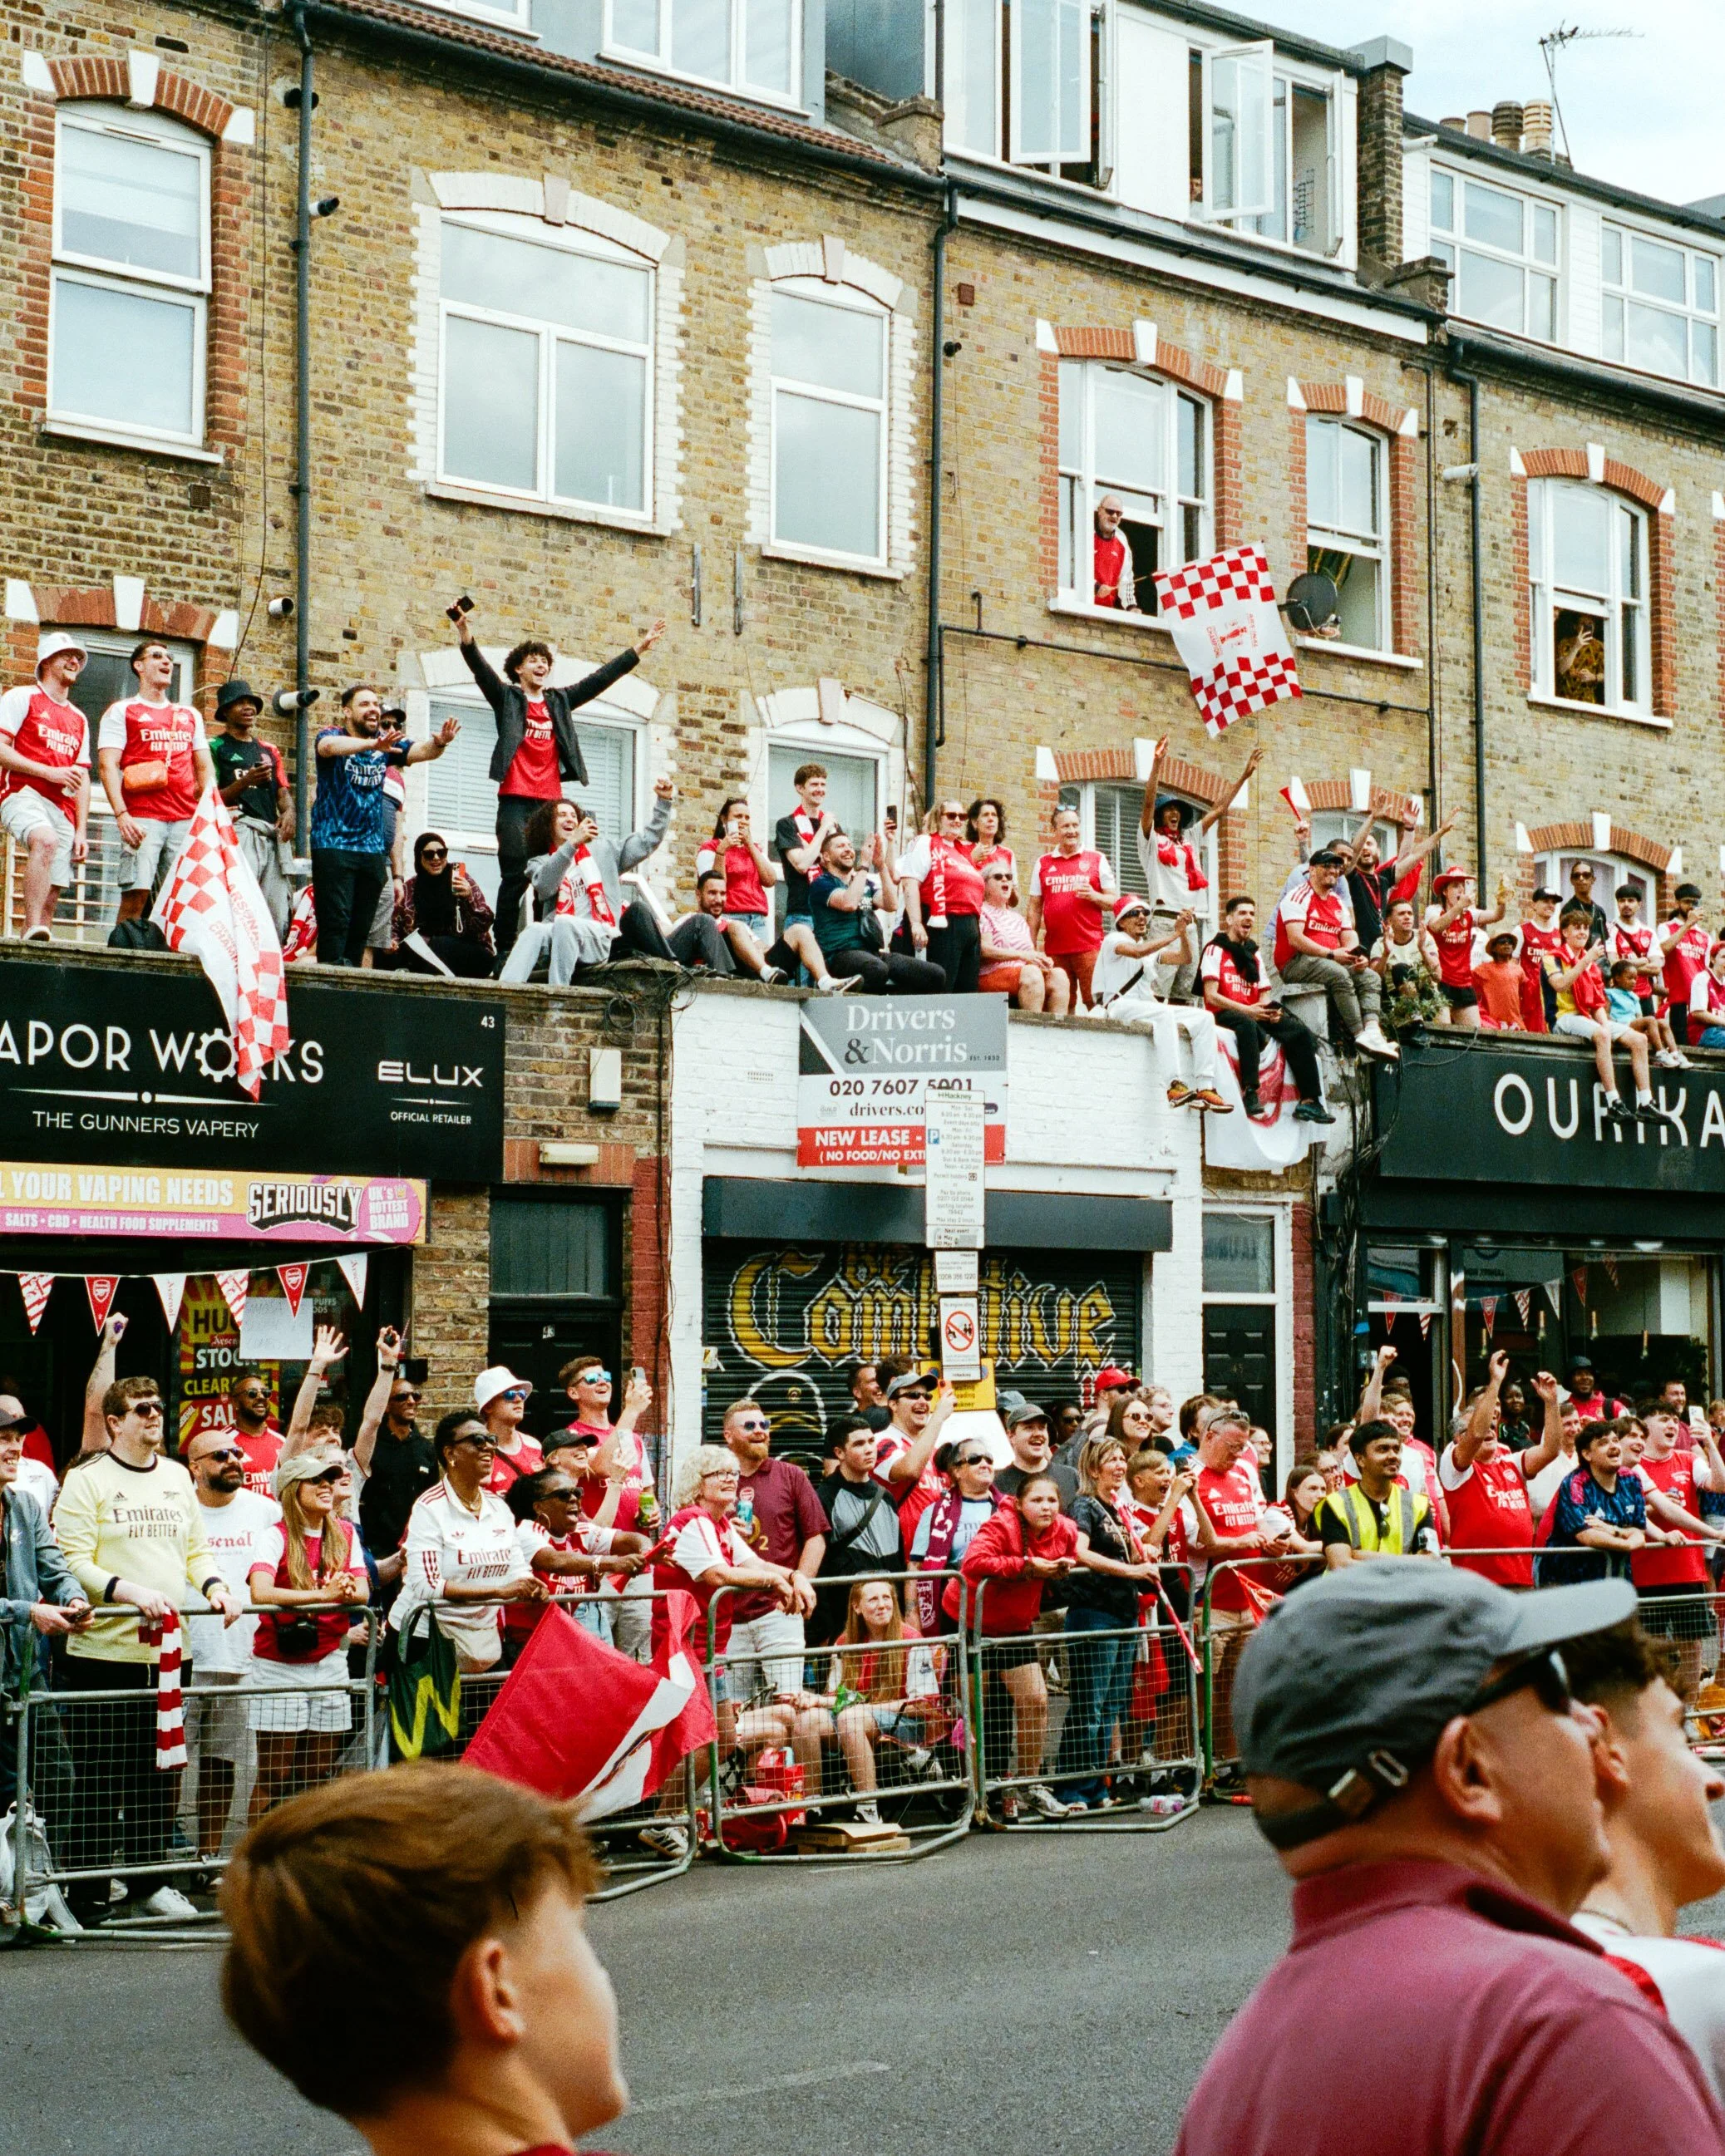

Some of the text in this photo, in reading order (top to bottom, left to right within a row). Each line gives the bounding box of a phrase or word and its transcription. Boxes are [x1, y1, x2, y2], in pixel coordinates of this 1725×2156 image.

[481, 1016, 495, 1029] 43
[845, 1002, 956, 1032] Drivers
[149, 1028, 323, 1083] WOKS
[378, 1061, 484, 1087] ELUX
[830, 1080, 865, 1095] 020
[871, 1080, 919, 1095] 7607
[391, 1111, 471, 1125] OFFICIAL RETAILER
[1495, 1072, 1725, 1148] OURIKA
[32, 1110, 259, 1138] THE GUNNERS VAPERY
[816, 1130, 856, 1147] NEW
[860, 1129, 910, 1145] LEASE
[11, 1170, 72, 1201] YOUR
[78, 1174, 161, 1204] VAPING
[166, 1177, 234, 1207] NEEDS
[249, 1183, 363, 1227] SERIOUSLY
[369, 1199, 408, 1215] HOTTEST
[5, 1213, 219, 1233] SALTS CBD HEALTH FOOD SUPPLEMENTS
[370, 1212, 409, 1231] BRAND
[195, 1348, 258, 1369] STOC
[113, 1505, 183, 1523] Emirates
[129, 1523, 178, 1538] FLY BETTER
[208, 1531, 254, 1548] senal
[467, 1564, 510, 1580] FLY BETTER
